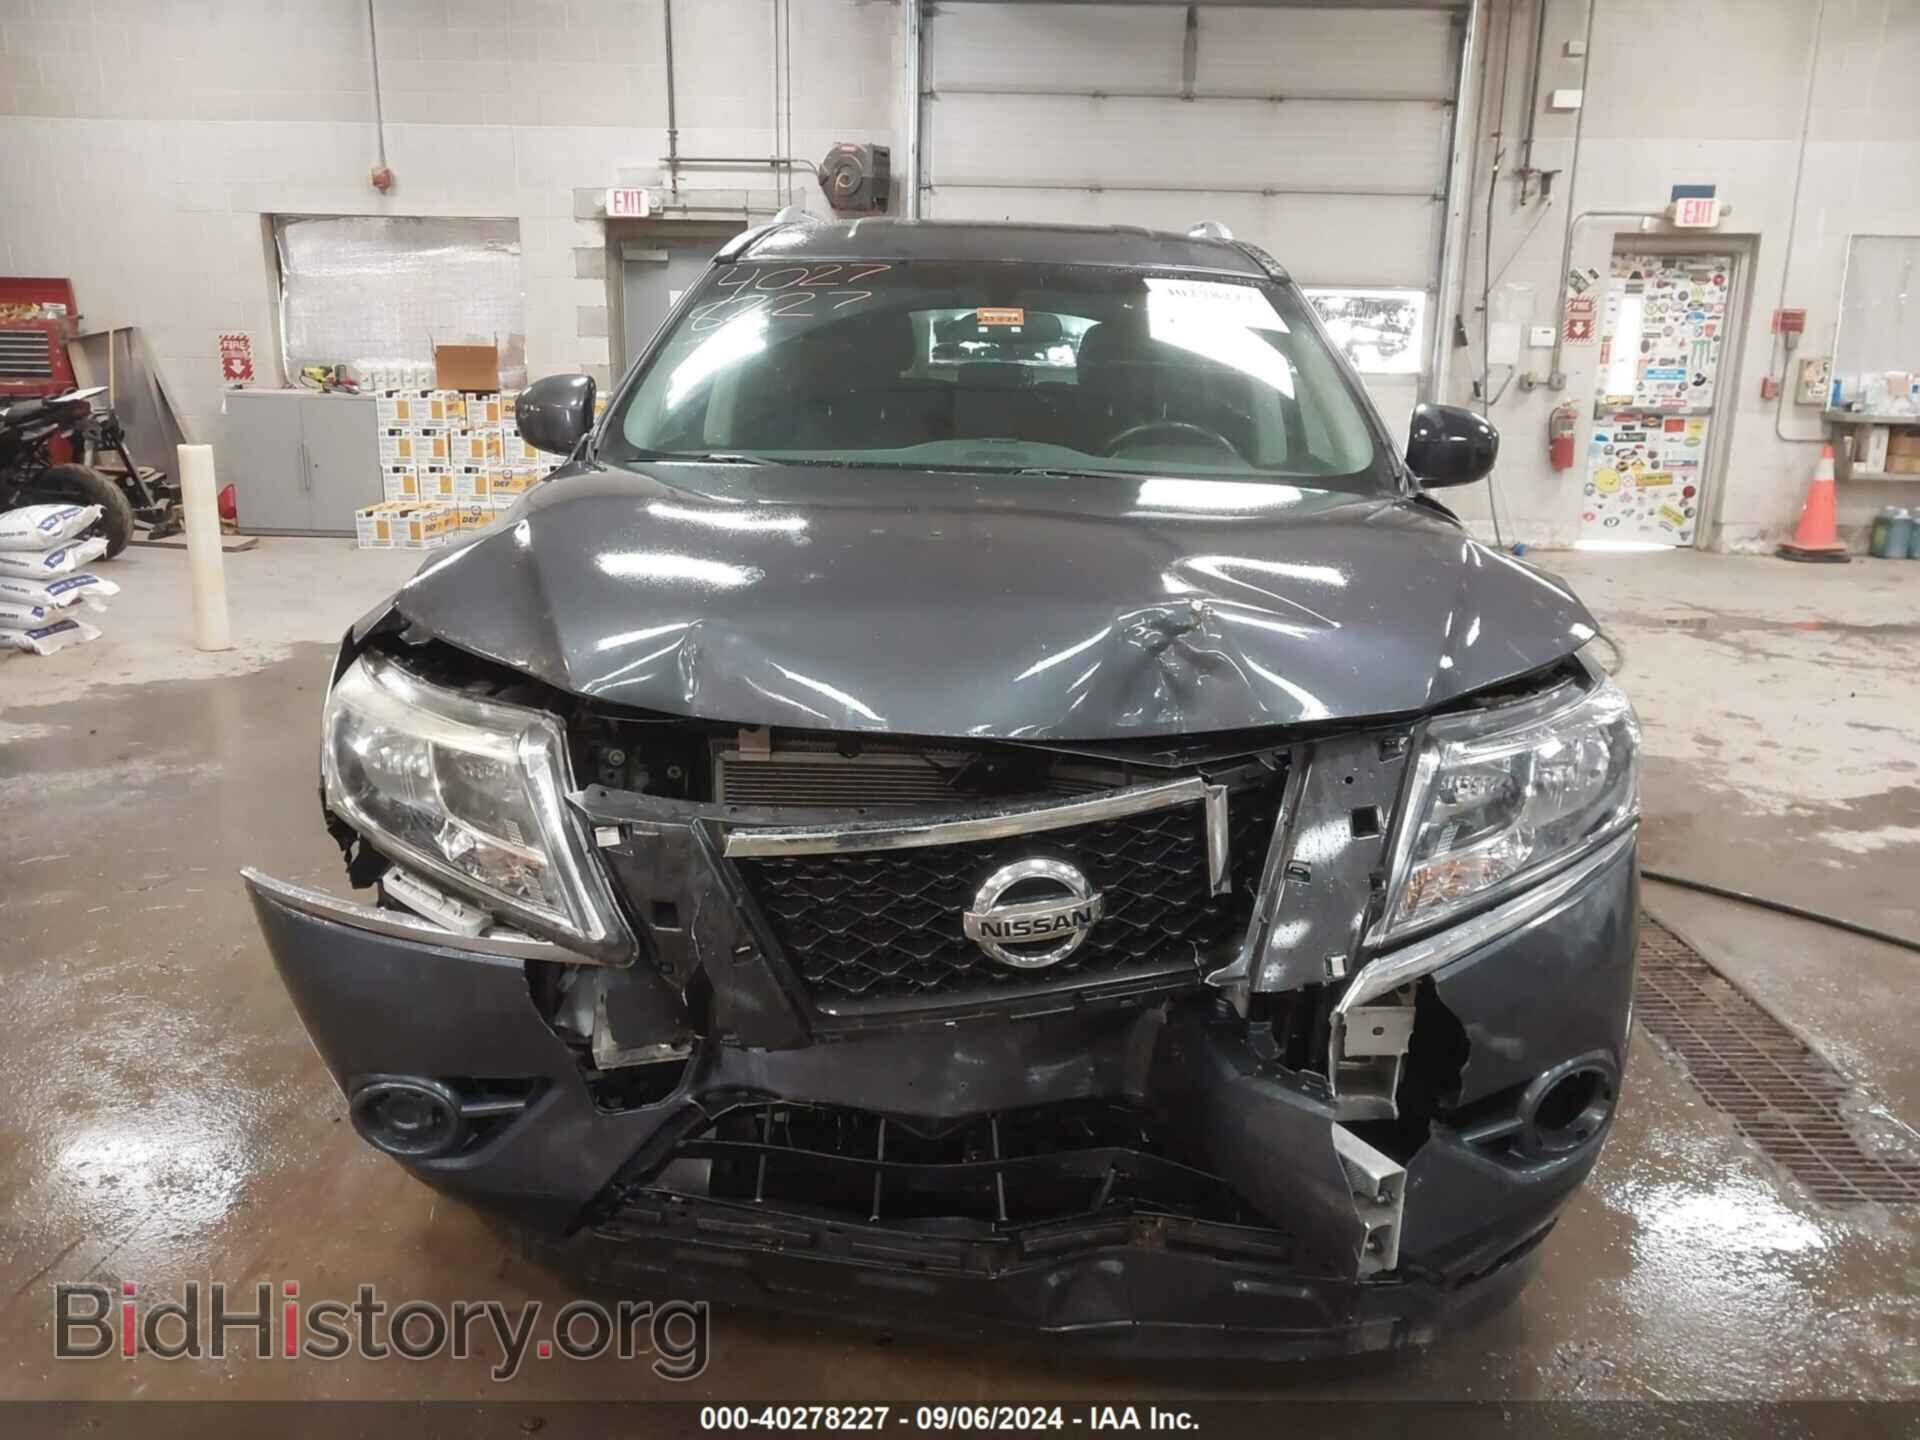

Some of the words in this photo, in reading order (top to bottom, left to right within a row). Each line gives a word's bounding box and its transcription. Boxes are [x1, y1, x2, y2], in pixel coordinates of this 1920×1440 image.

[614, 190, 642, 213] EXIT
[1683, 200, 1713, 224] EXIT
[717, 263, 892, 299] 4027
[223, 340, 247, 351] FIRE
[493, 480, 510, 488] DEF
[980, 906, 1092, 938] NISSAN
